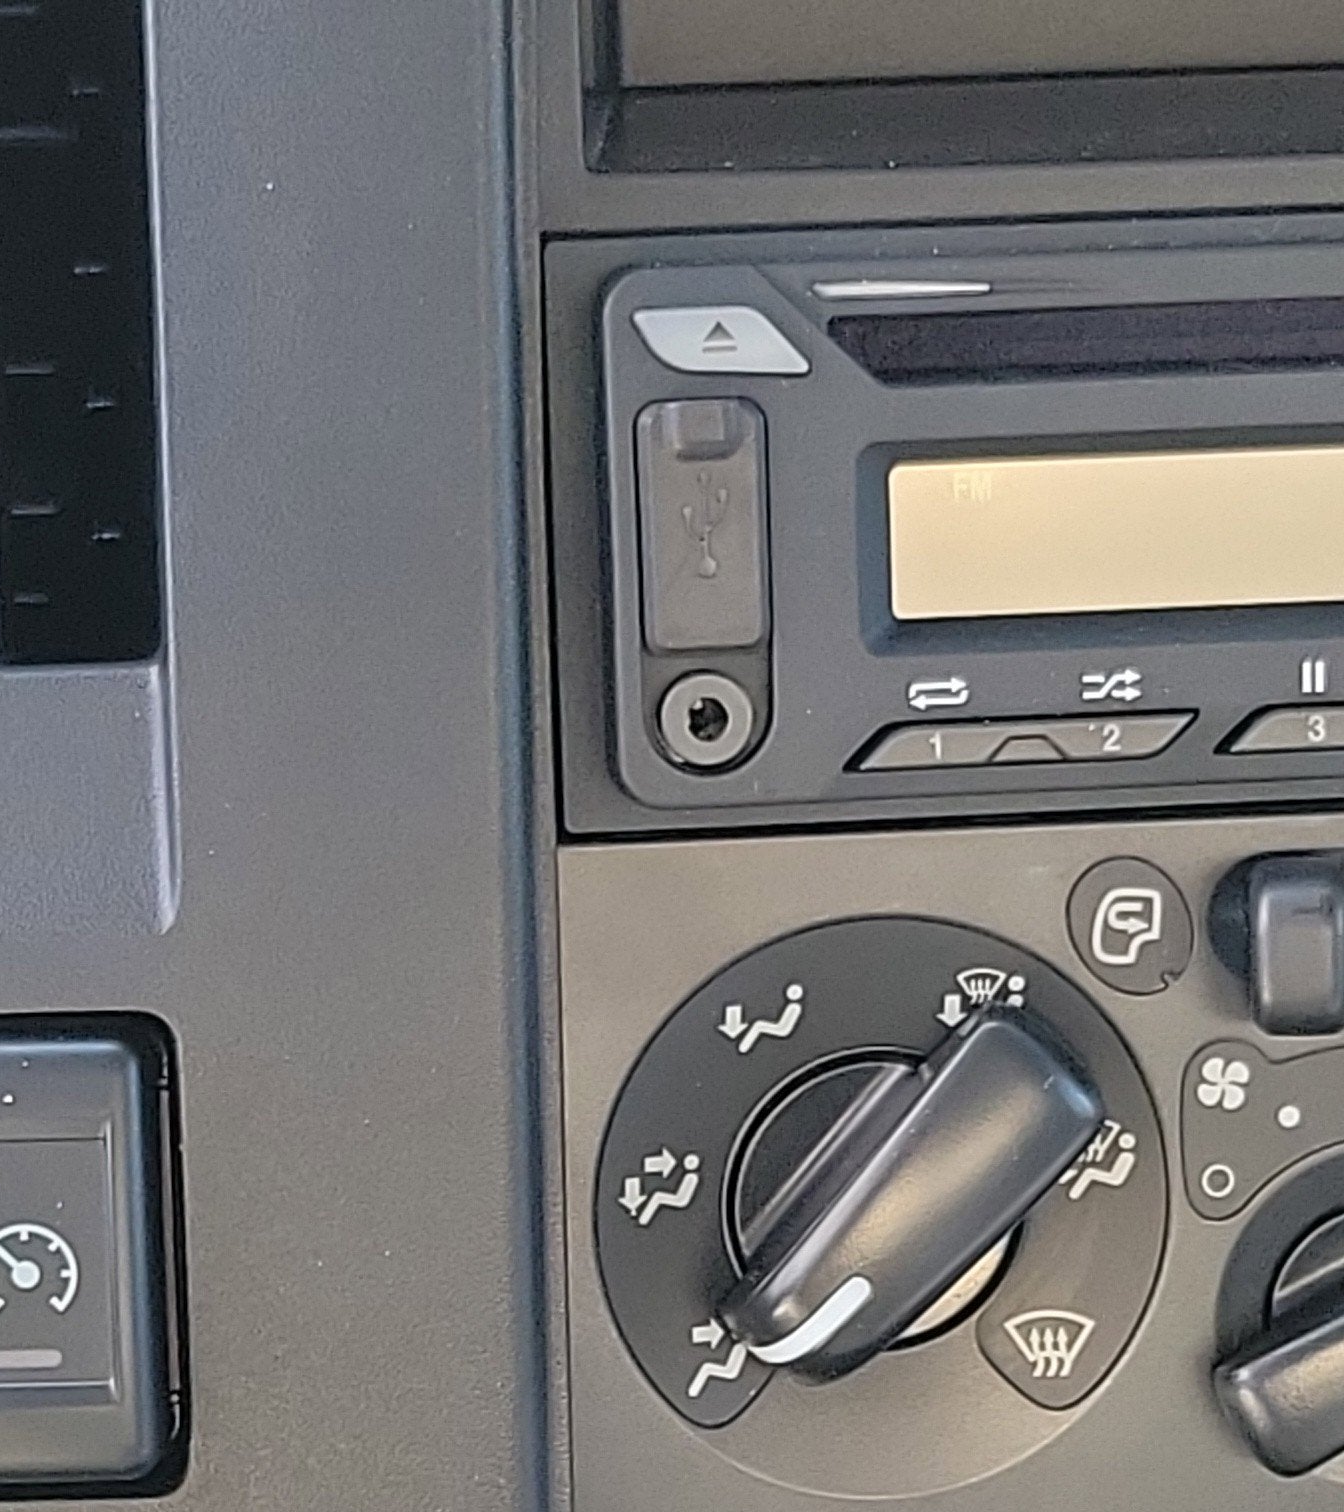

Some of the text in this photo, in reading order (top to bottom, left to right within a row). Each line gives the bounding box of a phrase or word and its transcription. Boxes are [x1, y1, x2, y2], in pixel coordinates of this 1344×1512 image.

[1100, 723, 1123, 751] 2
[1306, 714, 1327, 742] 3
[928, 733, 945, 761] 1
